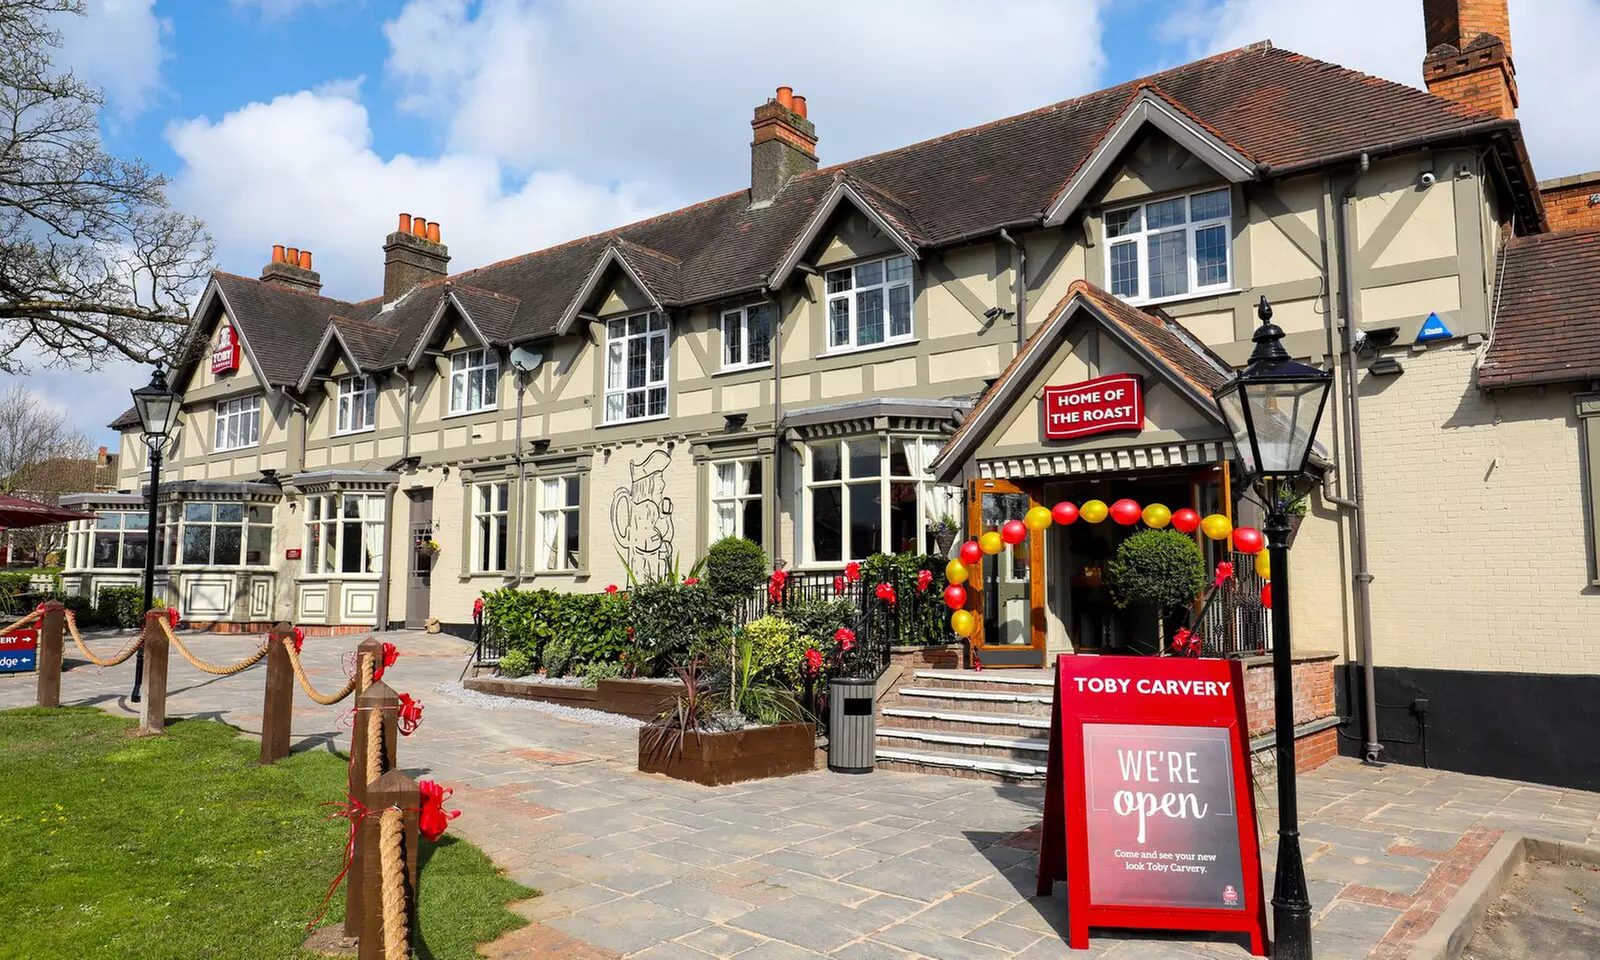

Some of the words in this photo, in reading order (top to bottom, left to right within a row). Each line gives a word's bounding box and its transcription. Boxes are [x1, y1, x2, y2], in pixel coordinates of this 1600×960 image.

[213, 350, 231, 363] TOBY
[1058, 391, 1101, 406] HOME
[1104, 388, 1124, 401] OF
[1051, 411, 1080, 424] THE
[1083, 406, 1133, 421] ROAST
[1074, 677, 1131, 693] TOBY
[1137, 679, 1231, 696] CARVERY
[1117, 749, 1200, 784] WE'RE
[1113, 790, 1208, 844] open
[1114, 848, 1140, 858] Come
[1141, 850, 1158, 859] and
[1159, 852, 1173, 860] see
[1175, 853, 1196, 862] your
[1125, 862, 1145, 870] look
[1147, 862, 1169, 873] Toby
[1170, 864, 1208, 874] Carvery.
